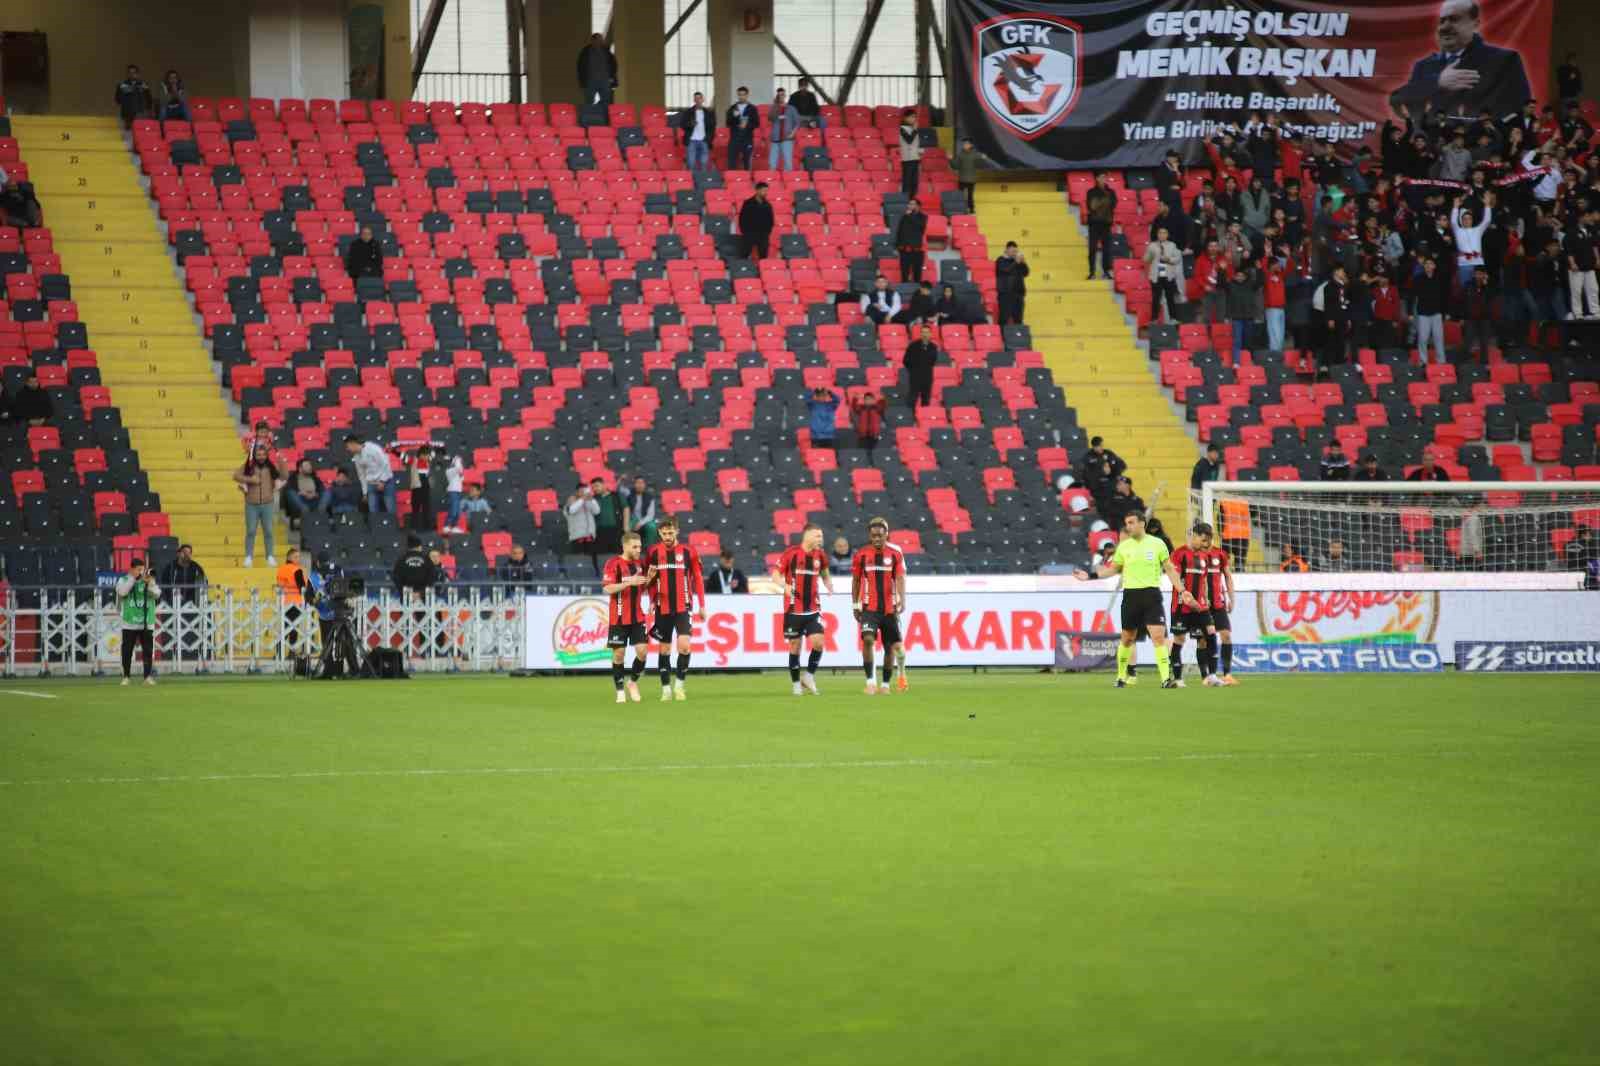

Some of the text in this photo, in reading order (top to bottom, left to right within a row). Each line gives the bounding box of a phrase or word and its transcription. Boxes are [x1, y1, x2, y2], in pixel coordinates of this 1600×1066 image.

[1001, 25, 1051, 44] GFK
[1146, 6, 1349, 41] GEÇMİŞ OLSUN
[1116, 41, 1377, 85] MEMİK BAŞKAN
[1250, 92, 1341, 113] Başardık,
[1124, 123, 1166, 140] Yine
[1273, 591, 1413, 631] Beşe
[560, 621, 609, 649] Beşle
[647, 611, 1117, 666] EŞLER AKARNA
